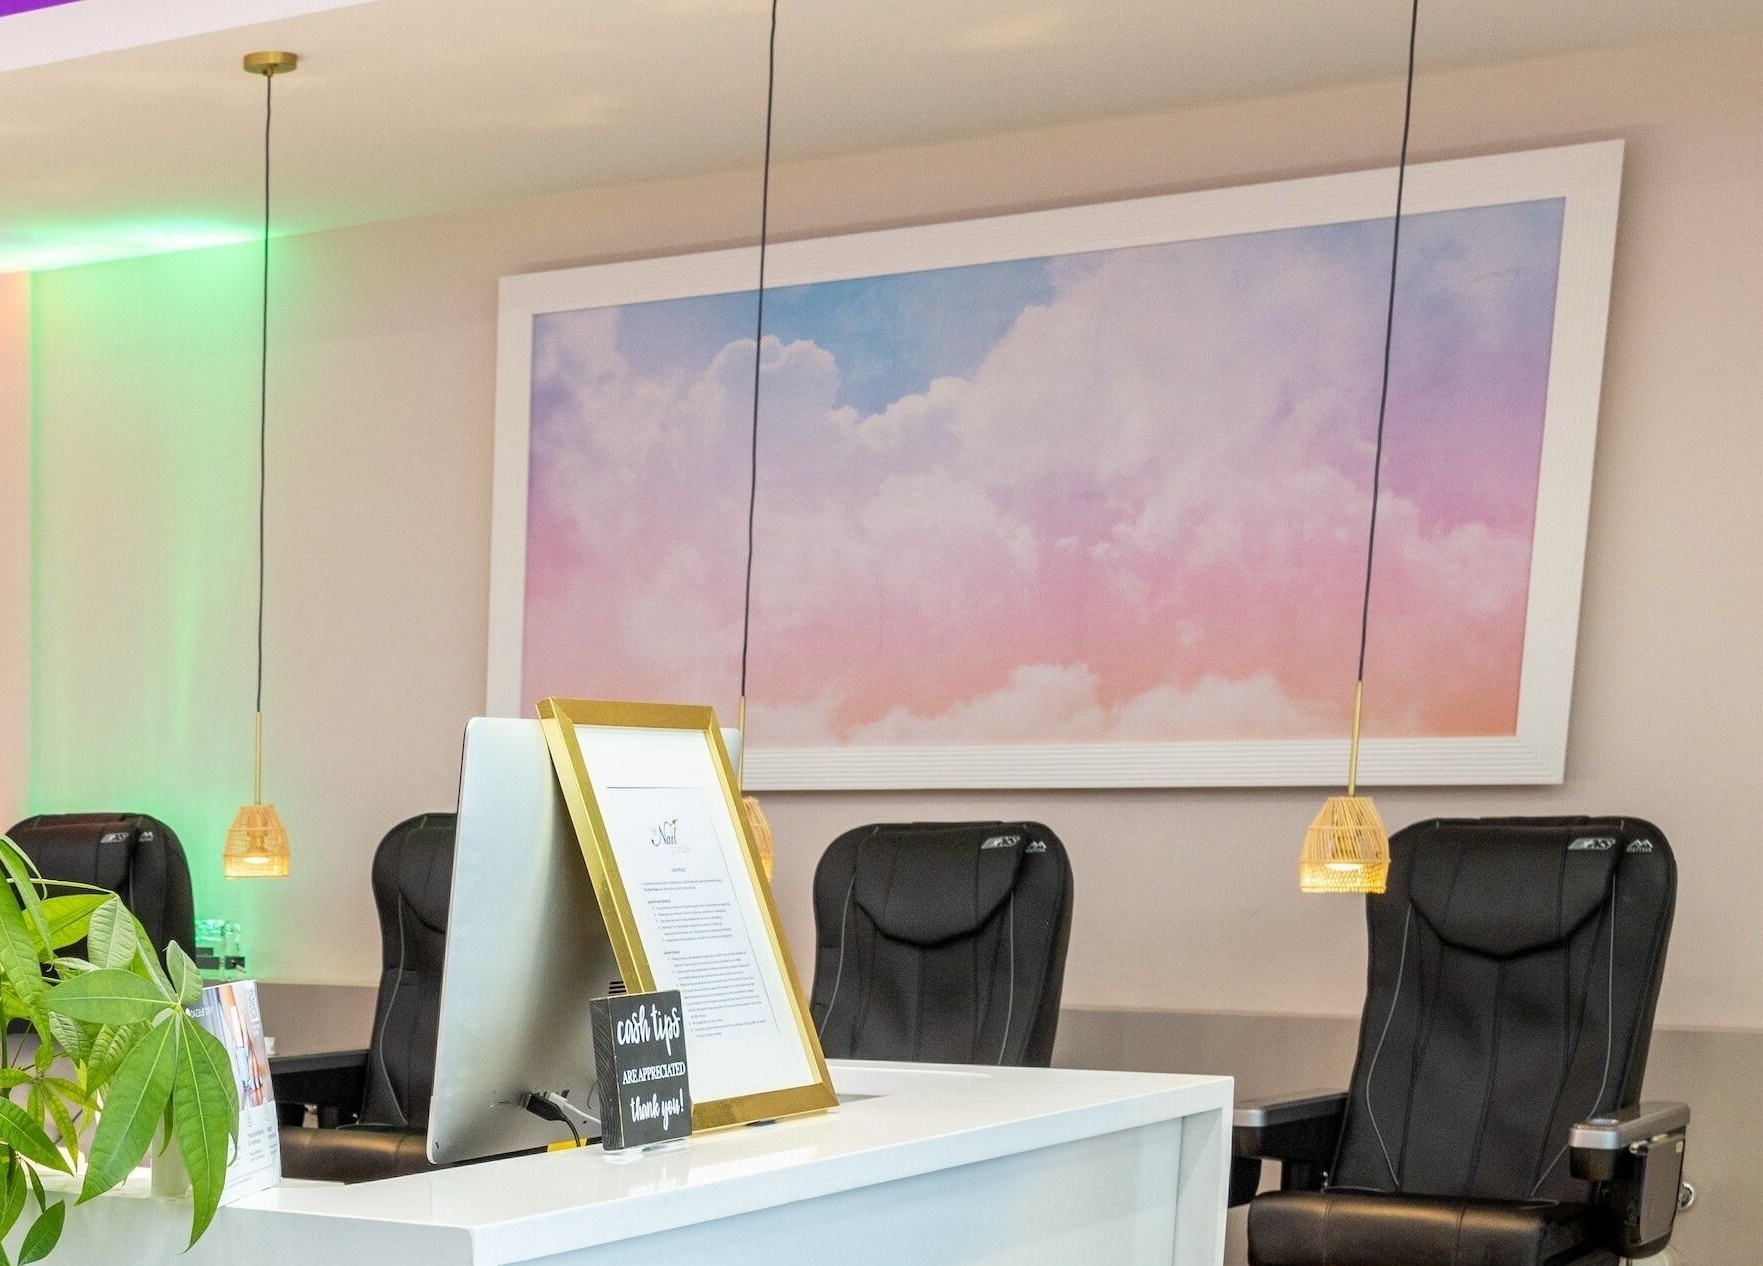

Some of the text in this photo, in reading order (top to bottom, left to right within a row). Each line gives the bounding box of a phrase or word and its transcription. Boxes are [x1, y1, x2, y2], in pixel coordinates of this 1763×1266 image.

[651, 820, 677, 847] Nail
[617, 1003, 681, 1057] cash tips
[622, 1061, 686, 1085] ARE APPRECIATED
[629, 1087, 685, 1131] thank you!
